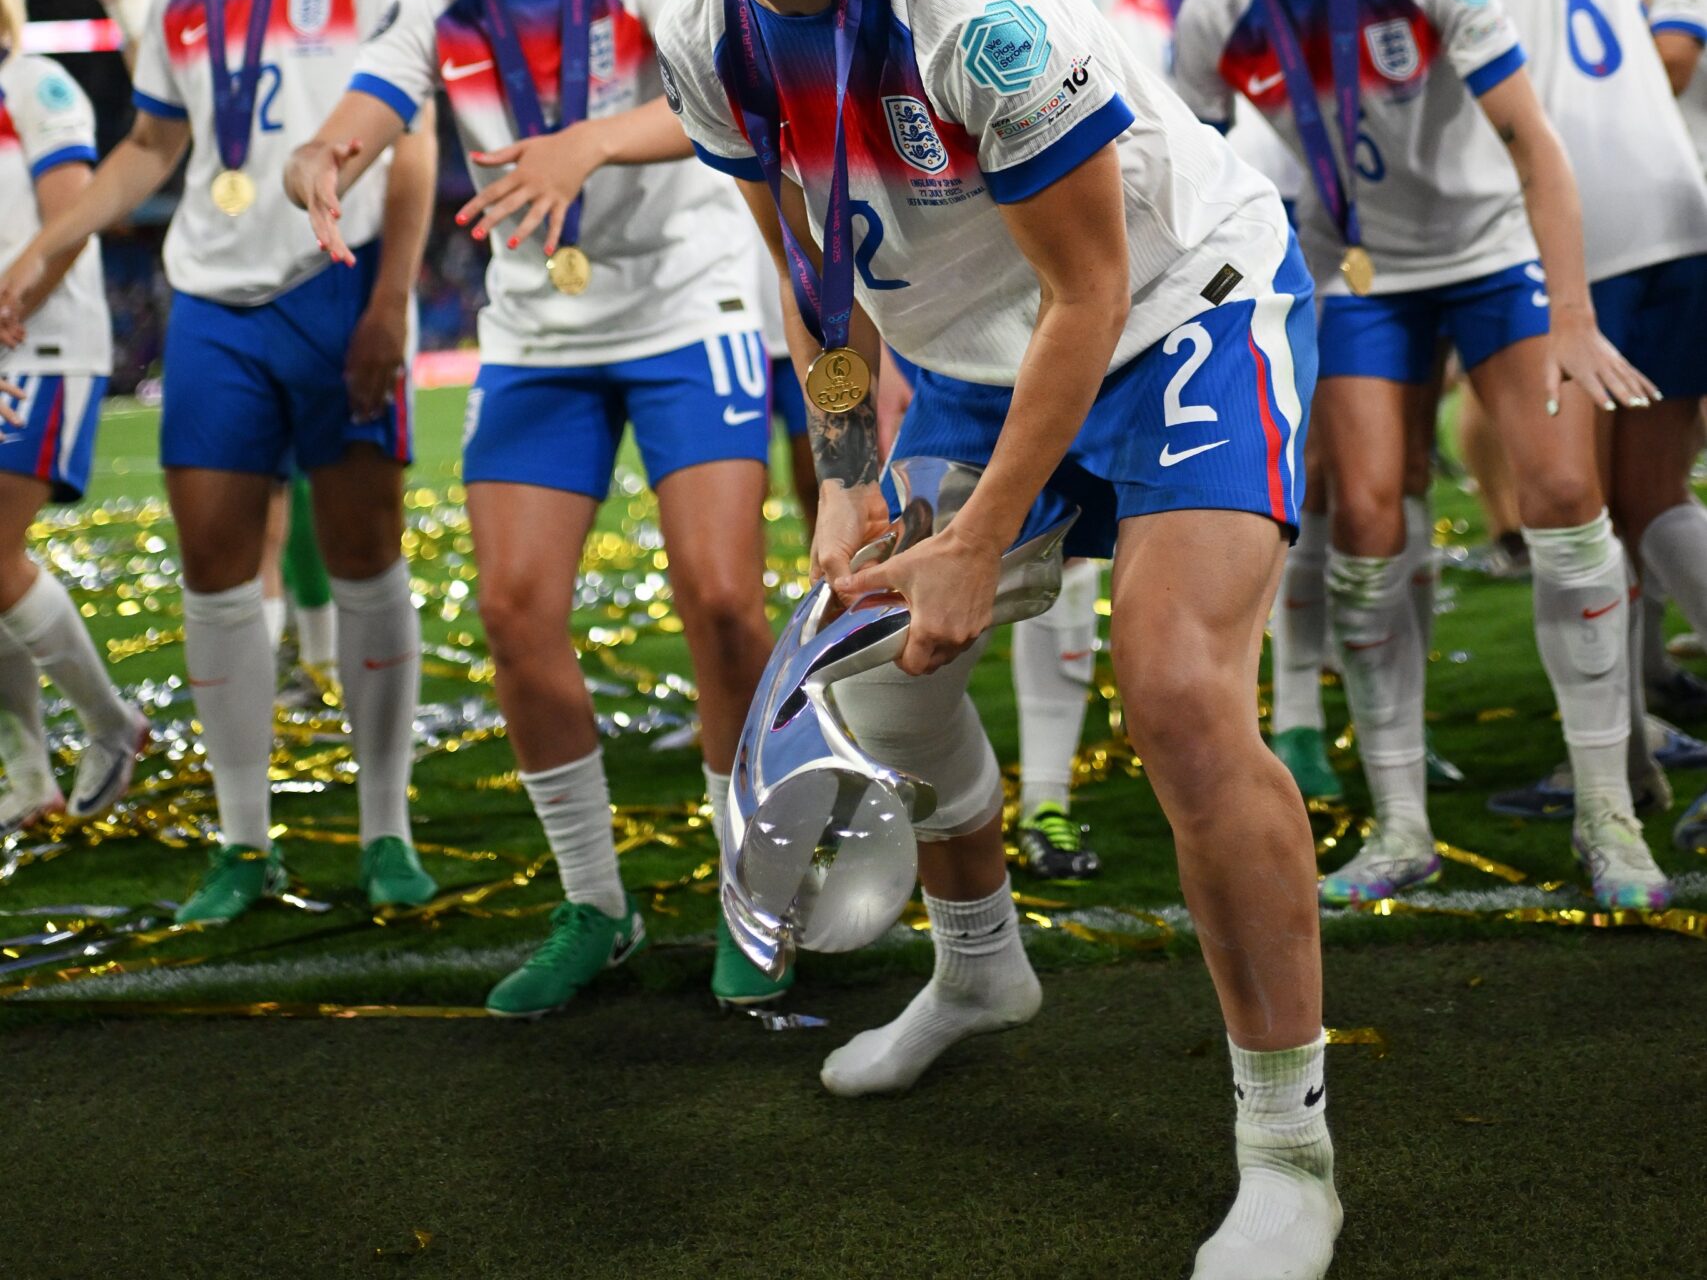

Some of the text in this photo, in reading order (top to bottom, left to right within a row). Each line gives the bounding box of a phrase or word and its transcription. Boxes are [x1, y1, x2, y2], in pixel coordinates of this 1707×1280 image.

[985, 38, 1001, 50] We
[1000, 40, 1031, 68] Strong
[1062, 67, 1089, 95] 10
[992, 118, 1011, 129] UEFA
[995, 91, 1066, 138] FOUNDATION
[848, 200, 912, 291] 2
[703, 330, 767, 399] 10
[1162, 320, 1219, 428] 2
